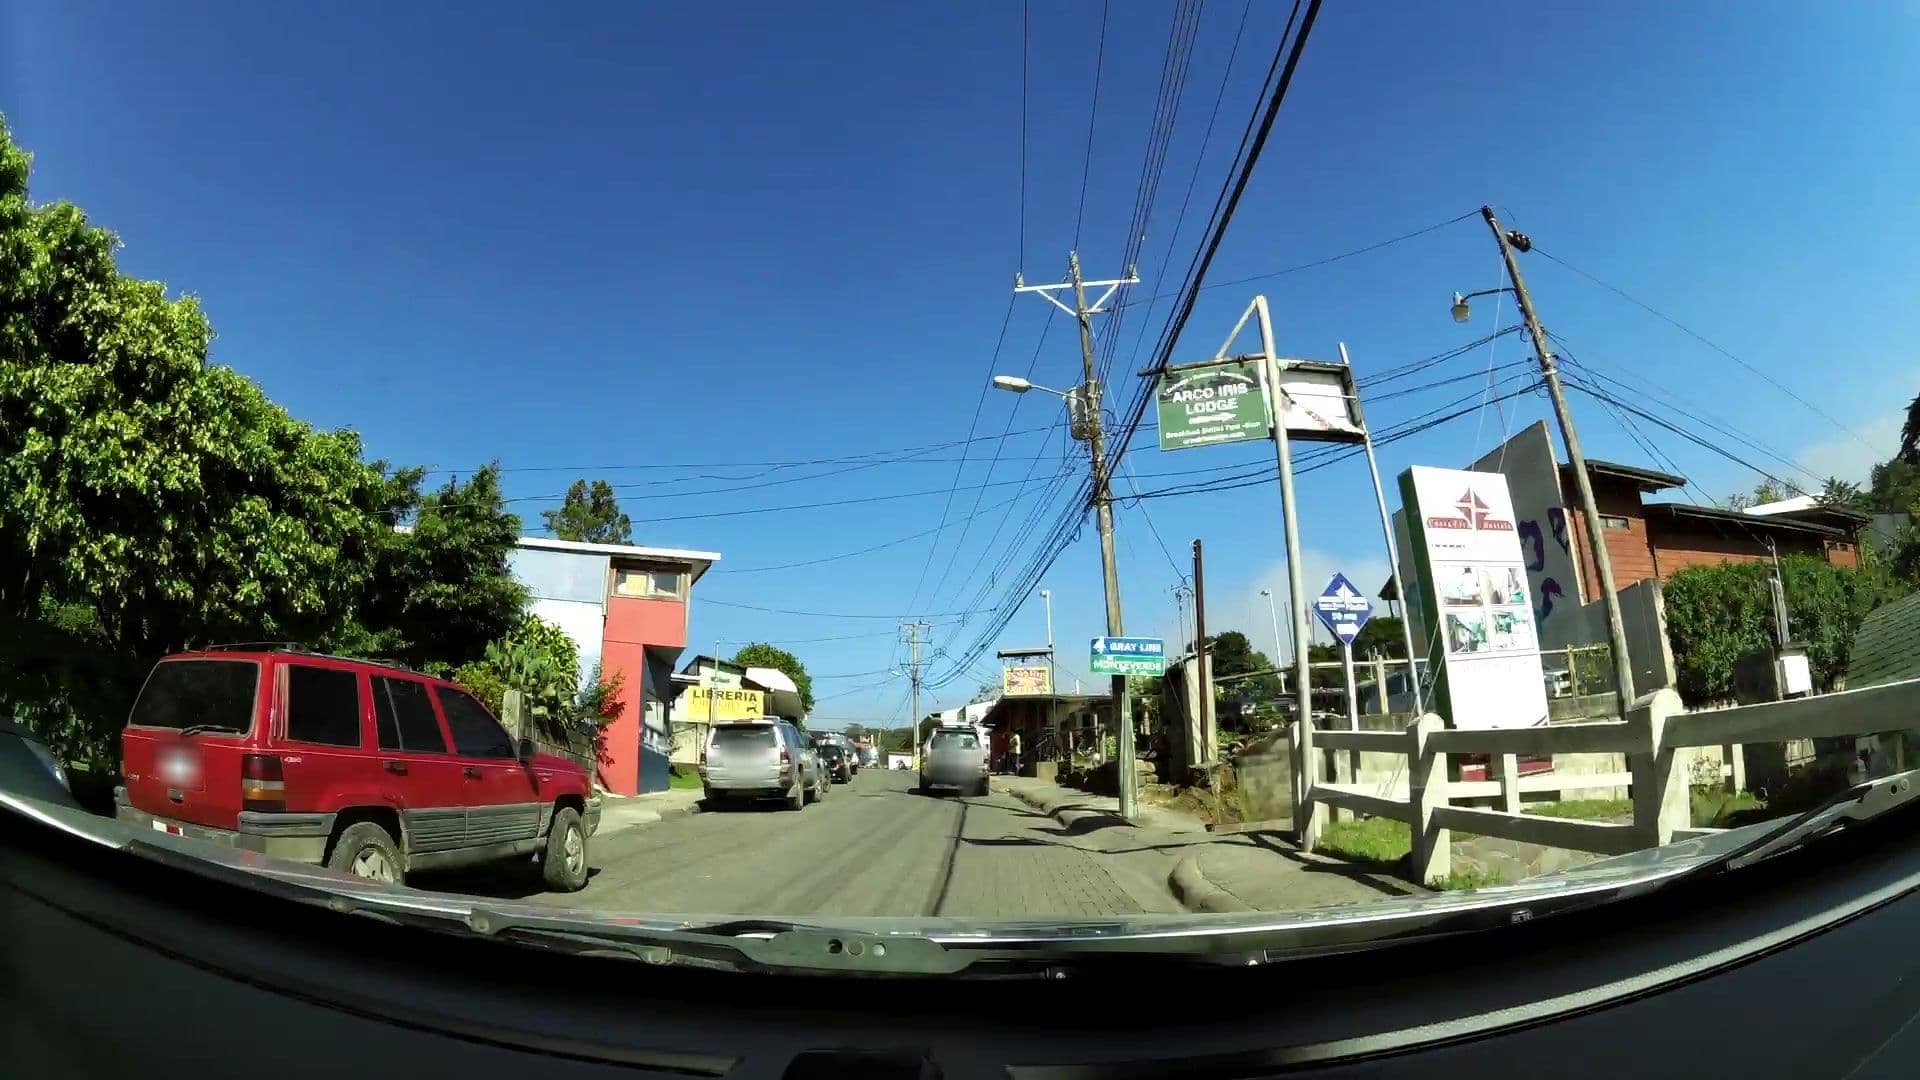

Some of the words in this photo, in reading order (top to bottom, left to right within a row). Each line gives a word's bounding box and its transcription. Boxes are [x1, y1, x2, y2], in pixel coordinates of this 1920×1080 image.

[1172, 387, 1214, 404] ARCO
[1218, 382, 1248, 398] IRIS
[1185, 398, 1238, 415] LODGE
[1109, 641, 1137, 652] GRAY
[1139, 643, 1162, 653] LINE
[692, 688, 758, 703] LIBRERIA
